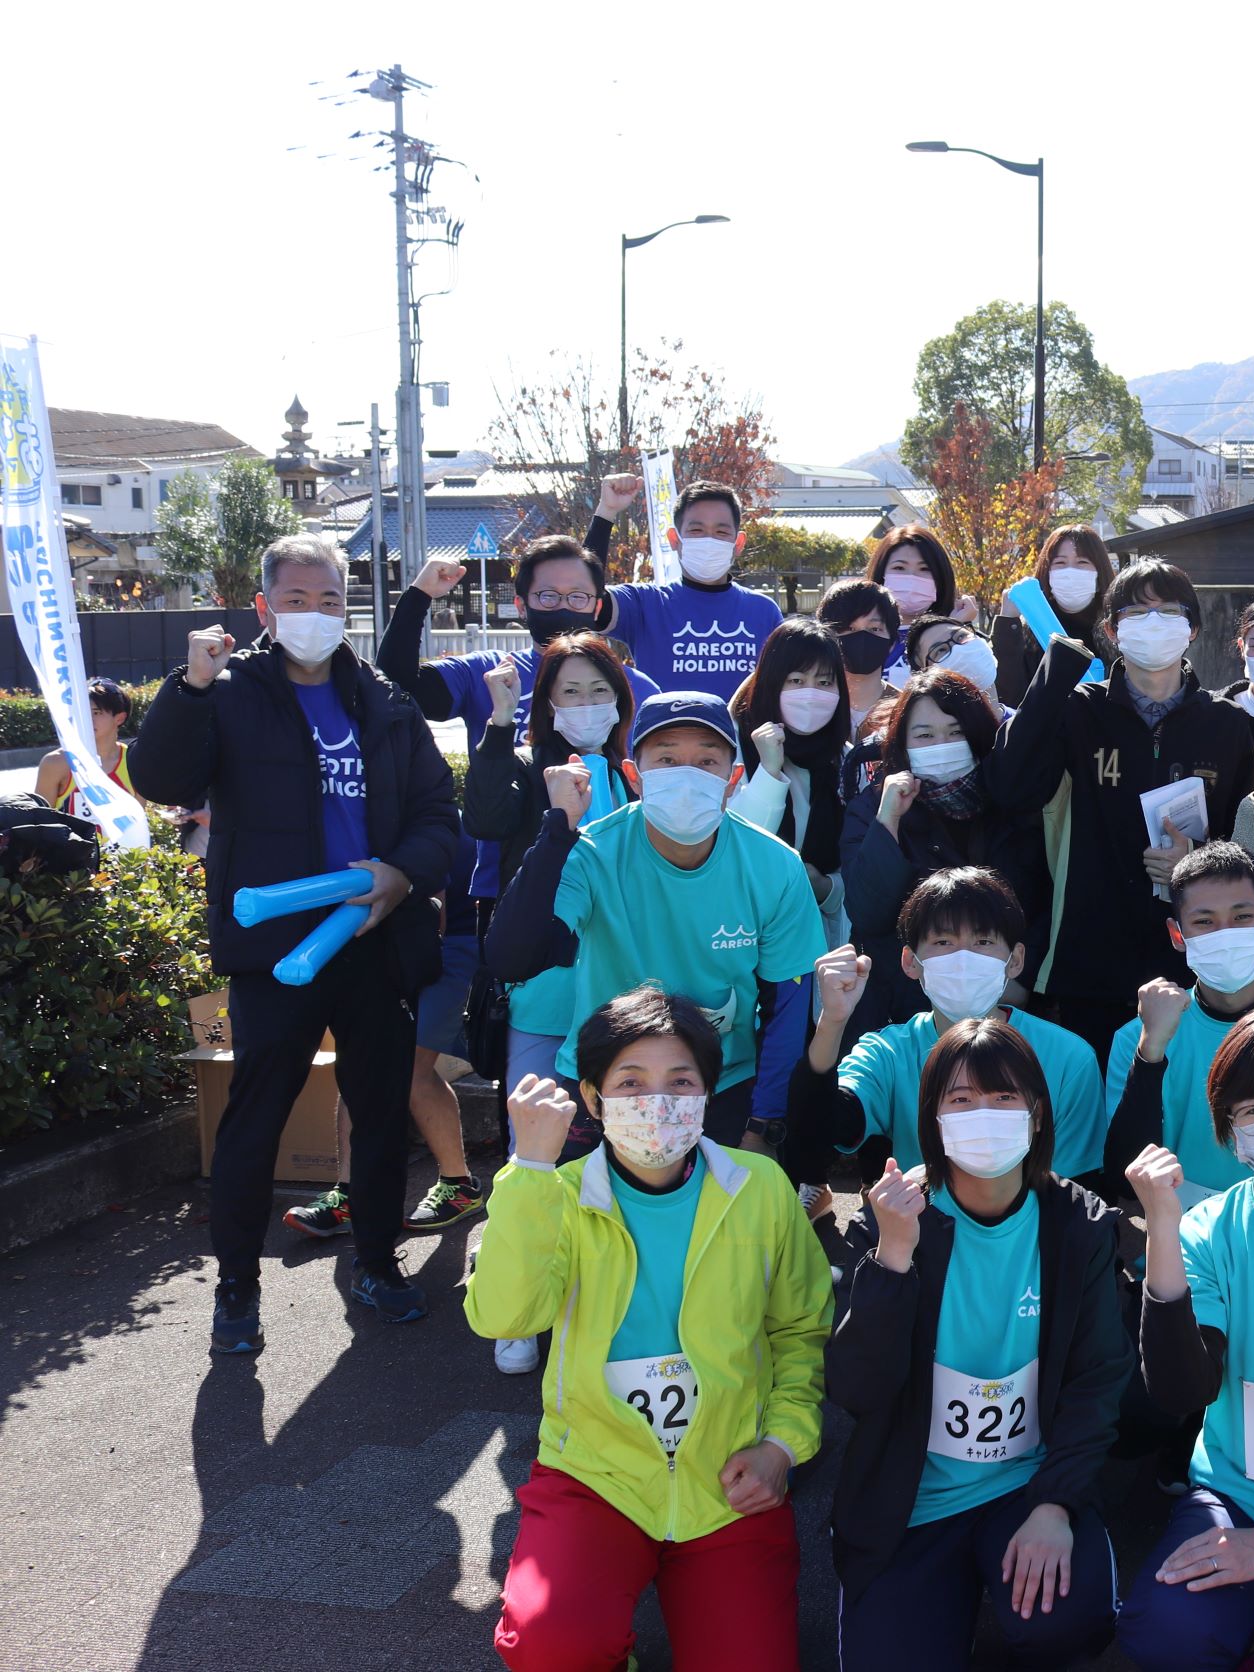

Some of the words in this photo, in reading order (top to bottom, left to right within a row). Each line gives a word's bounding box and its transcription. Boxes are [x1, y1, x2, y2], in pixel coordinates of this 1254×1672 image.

[672, 642, 756, 657] CAREOTH
[672, 658, 756, 673] HOLDINGS
[318, 754, 366, 776] EOTH
[1093, 747, 1121, 787] 14
[711, 937, 758, 950] CAREOT
[627, 1384, 698, 1429] 32
[945, 1396, 1026, 1443] 322
[966, 1446, 1007, 1459] キャレオス
